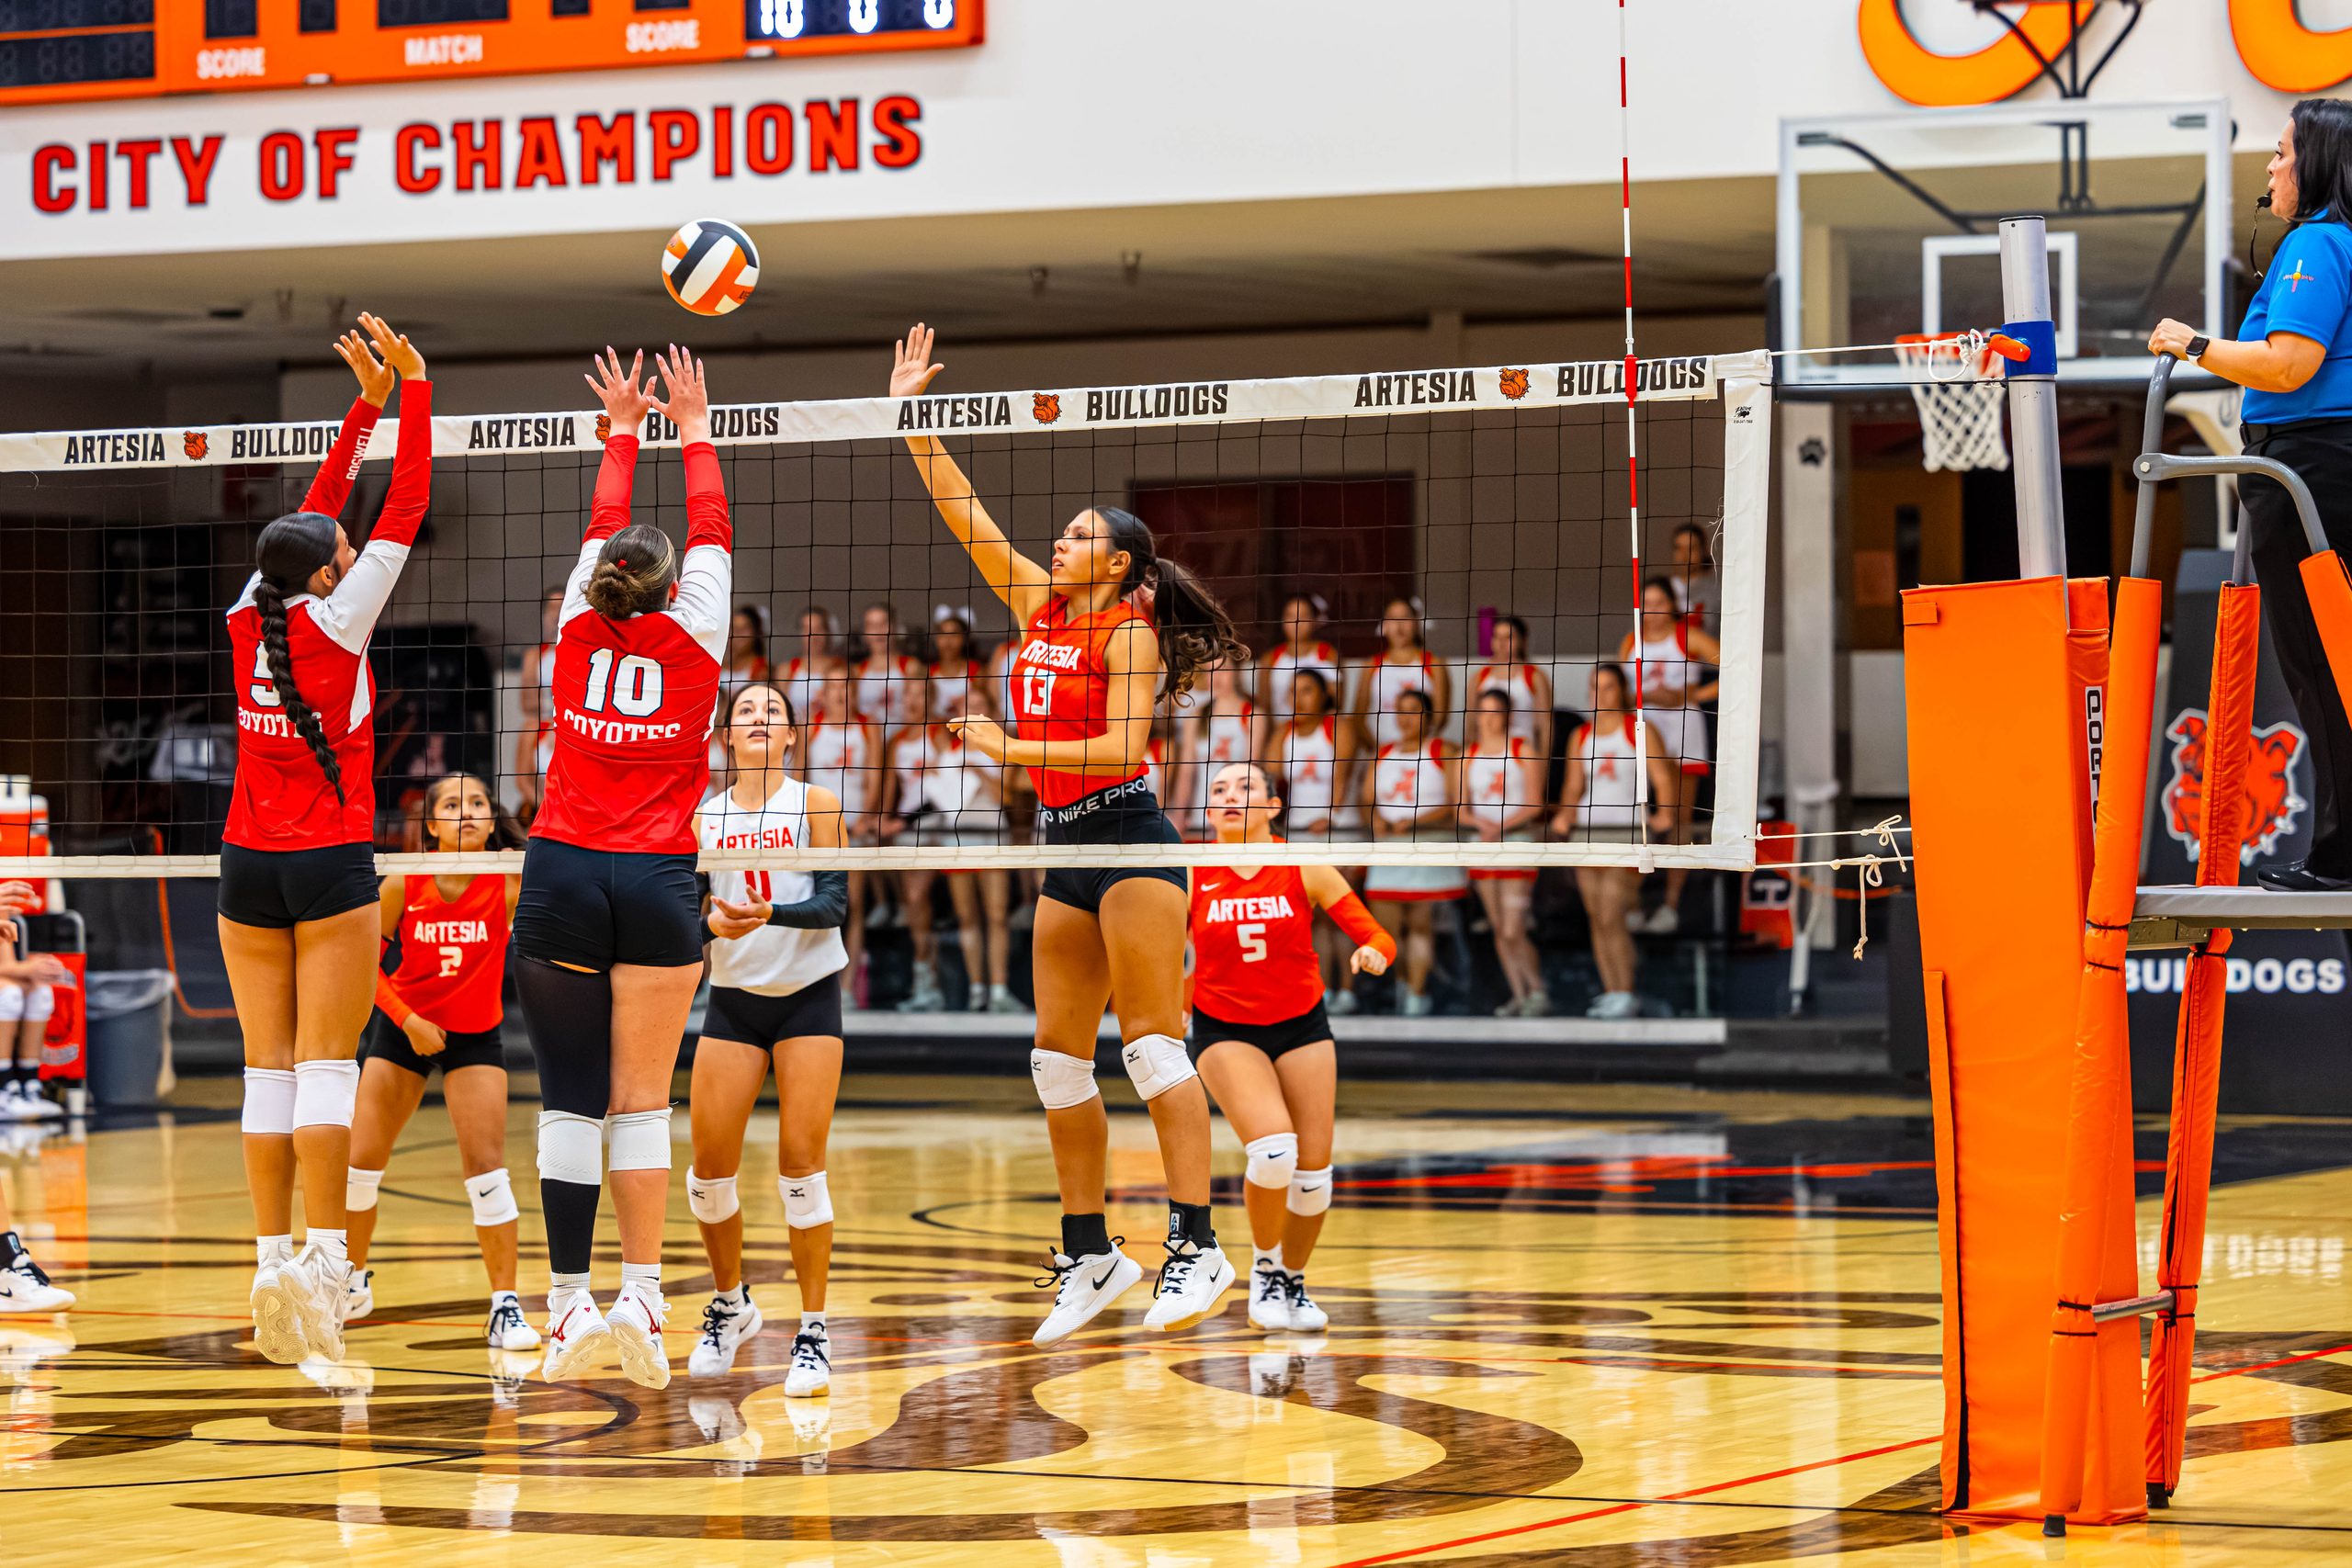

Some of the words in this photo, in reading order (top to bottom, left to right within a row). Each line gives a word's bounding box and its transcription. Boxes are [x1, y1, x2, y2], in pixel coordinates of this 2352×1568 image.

[404, 35, 482, 66] MATCH
[626, 20, 700, 53] SCORE
[197, 48, 266, 79] SCORE
[32, 135, 225, 214] CITY
[258, 127, 360, 201] OF
[394, 94, 923, 195] CHAMPIONS
[1354, 370, 1477, 407] ARTESIA
[1556, 357, 1707, 397] BULLDOGS
[897, 396, 1012, 430] ARTESIA
[1086, 384, 1228, 421] BULLDOGS
[63, 434, 166, 464] ARTESIA
[232, 426, 340, 458] BULLDOG
[469, 416, 576, 449] ARTESIA
[646, 407, 779, 441] BUDOGS
[345, 427, 373, 481] ROSWELL
[250, 639, 281, 707] 5
[1020, 639, 1082, 671] ARTESIA
[583, 648, 663, 717] 10
[1023, 666, 1057, 716] 13
[1058, 795, 1101, 823] NIKE
[1104, 779, 1147, 805] PRO
[1205, 895, 1295, 923] ARTESIA
[413, 920, 489, 943] ARTESIA
[1237, 922, 1267, 963] 5
[438, 946, 463, 977] 2
[2124, 957, 2345, 994] BULDOGS
